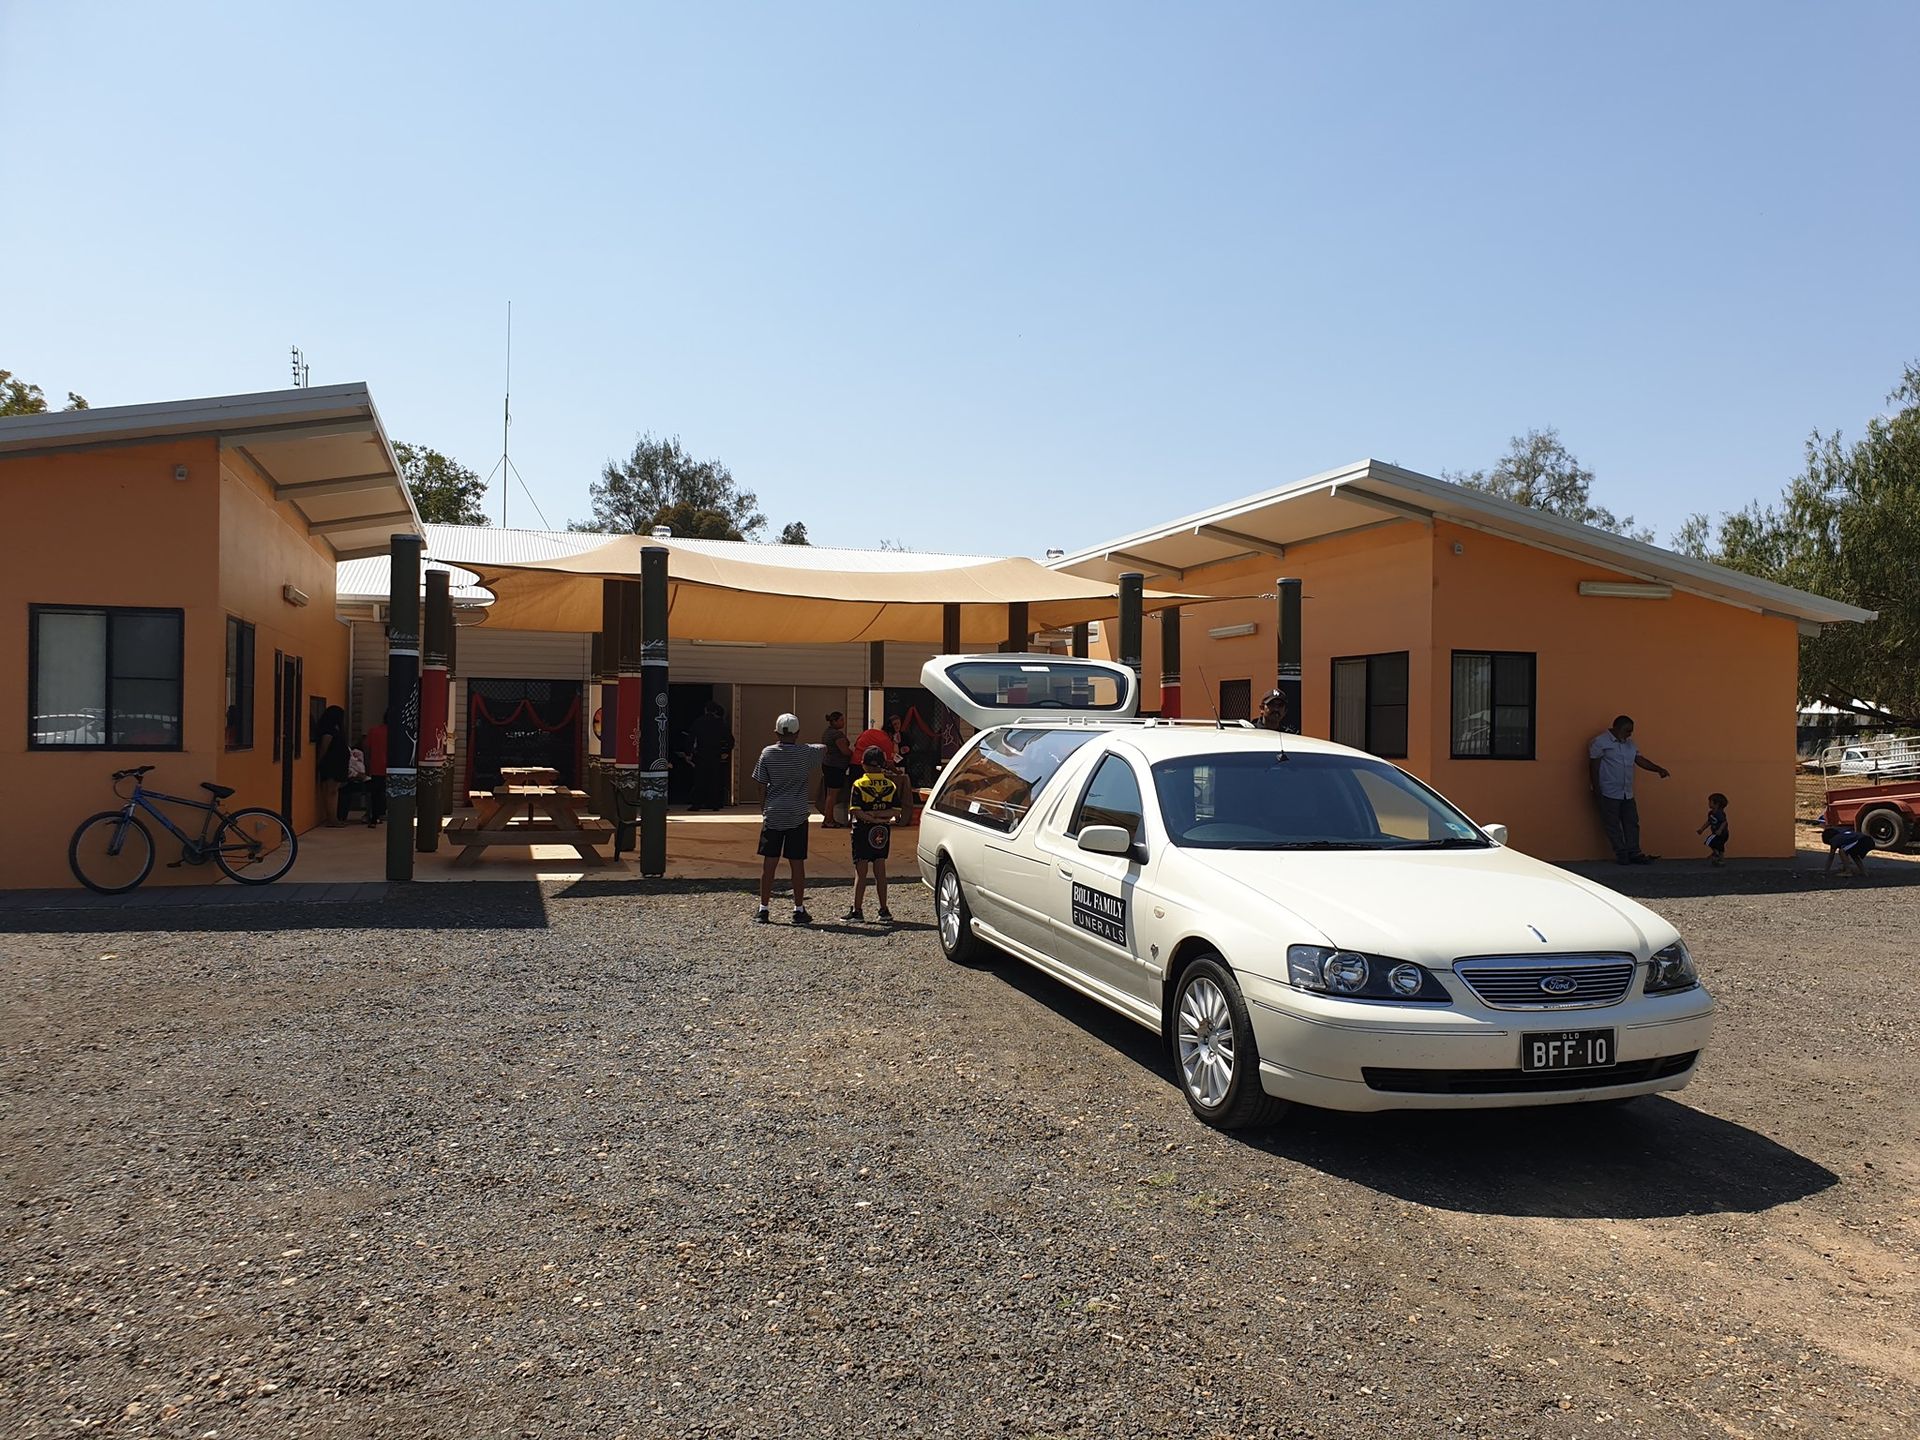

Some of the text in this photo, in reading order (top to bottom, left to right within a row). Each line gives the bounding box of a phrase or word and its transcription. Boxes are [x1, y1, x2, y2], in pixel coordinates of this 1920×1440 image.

[1093, 893, 1124, 919] FAMILY
[1073, 911, 1124, 943] FUNERALS
[1548, 979, 1570, 990] Ford
[1562, 1032, 1580, 1040] QLD
